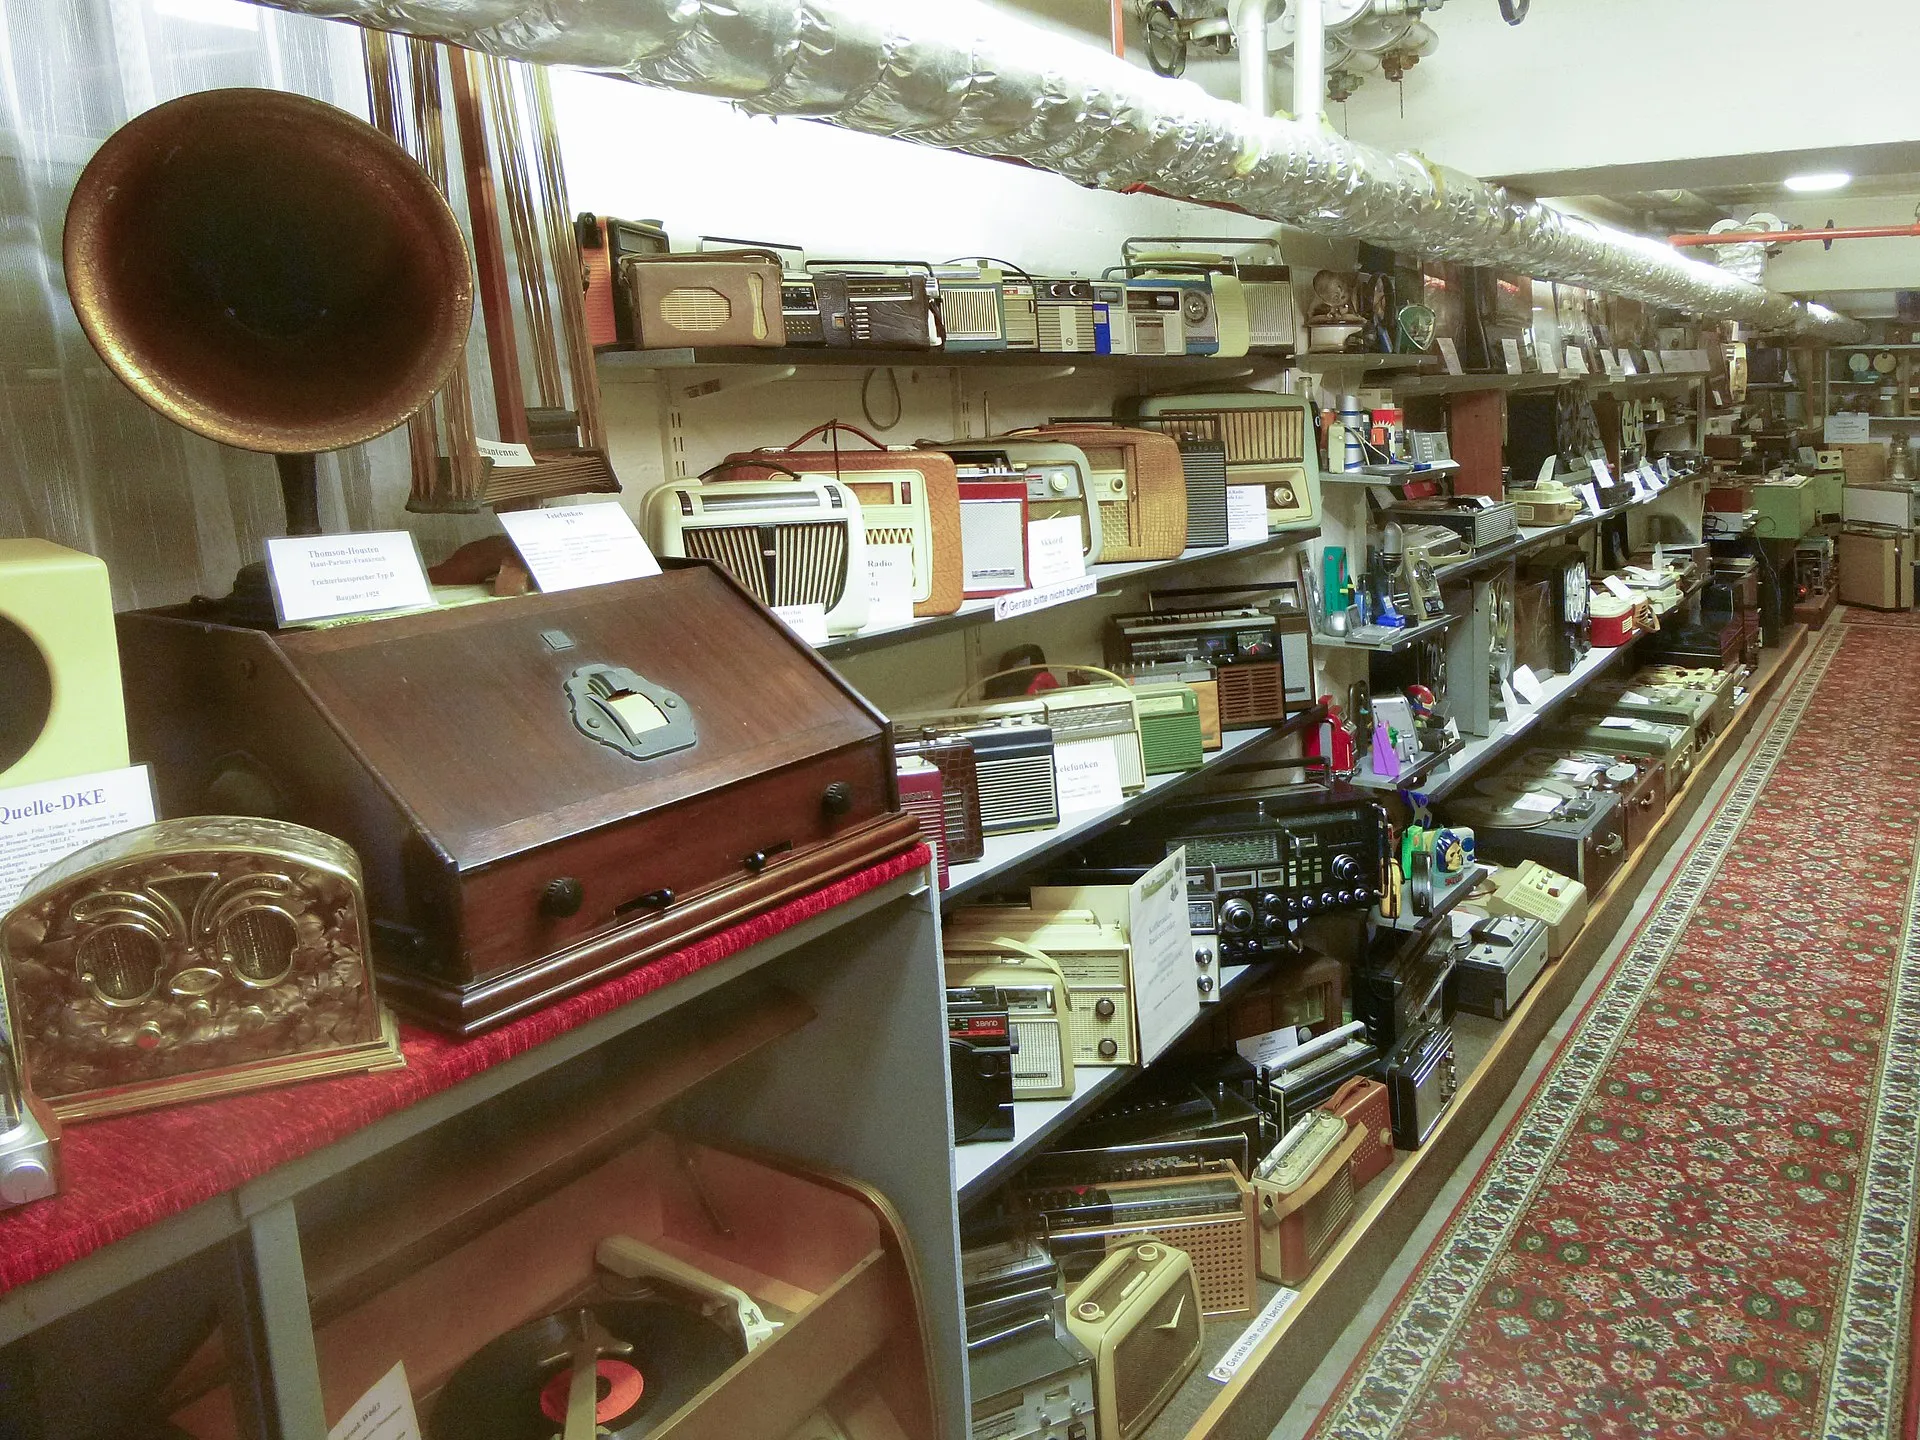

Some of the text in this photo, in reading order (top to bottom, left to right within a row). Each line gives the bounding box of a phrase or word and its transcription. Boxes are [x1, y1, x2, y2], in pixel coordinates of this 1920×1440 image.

[1009, 598, 1032, 611] Geräte
[1033, 594, 1048, 605] bitte
[1049, 589, 1065, 600] nicht
[1056, 760, 1098, 773] elefunken
[0, 788, 107, 825] Quelle-DKE
[1226, 1346, 1248, 1367] Geräte
[1246, 1333, 1259, 1346] bitte
[1257, 1317, 1273, 1333] nicht
